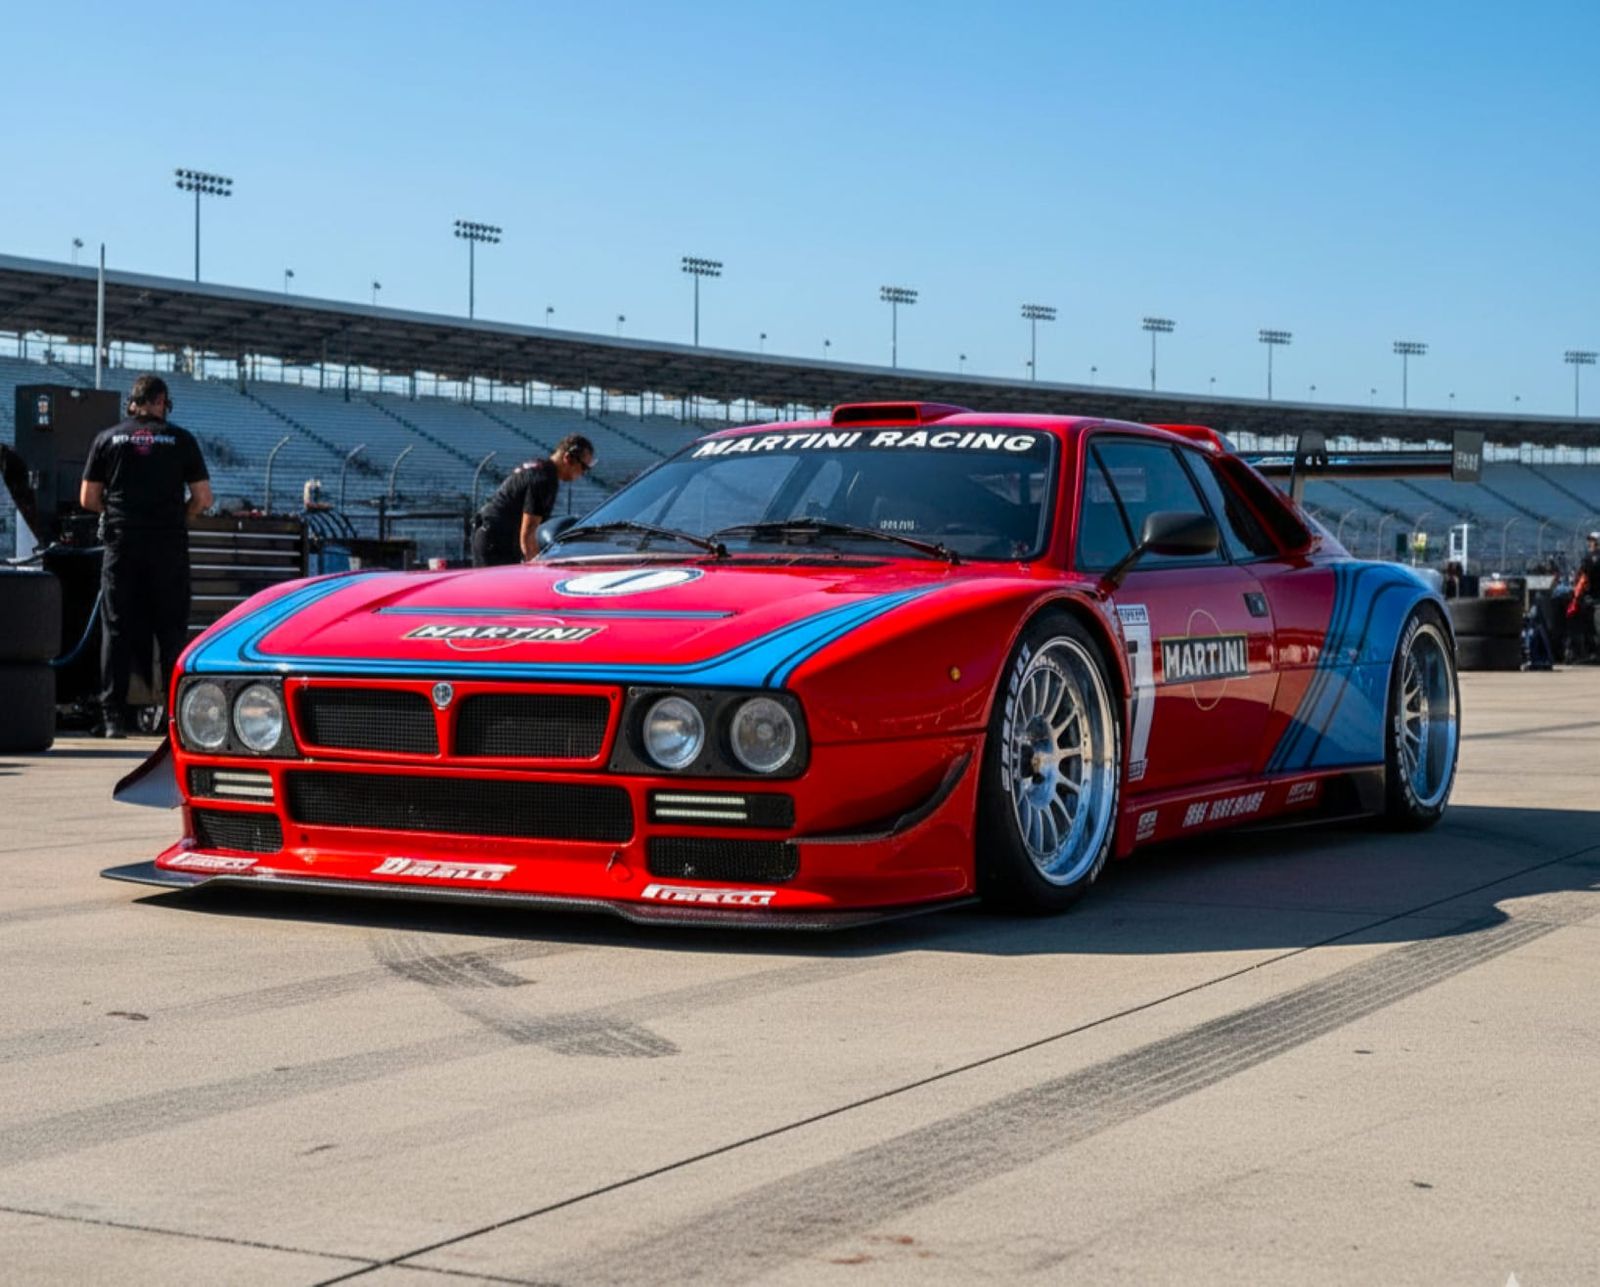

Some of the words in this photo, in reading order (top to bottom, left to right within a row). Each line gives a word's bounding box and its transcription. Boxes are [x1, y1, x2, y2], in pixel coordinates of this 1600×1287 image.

[691, 431, 863, 458] MARTINI
[869, 431, 1036, 451] RACING
[415, 625, 592, 640] MARTINI
[1165, 639, 1246, 679] MARTINI
